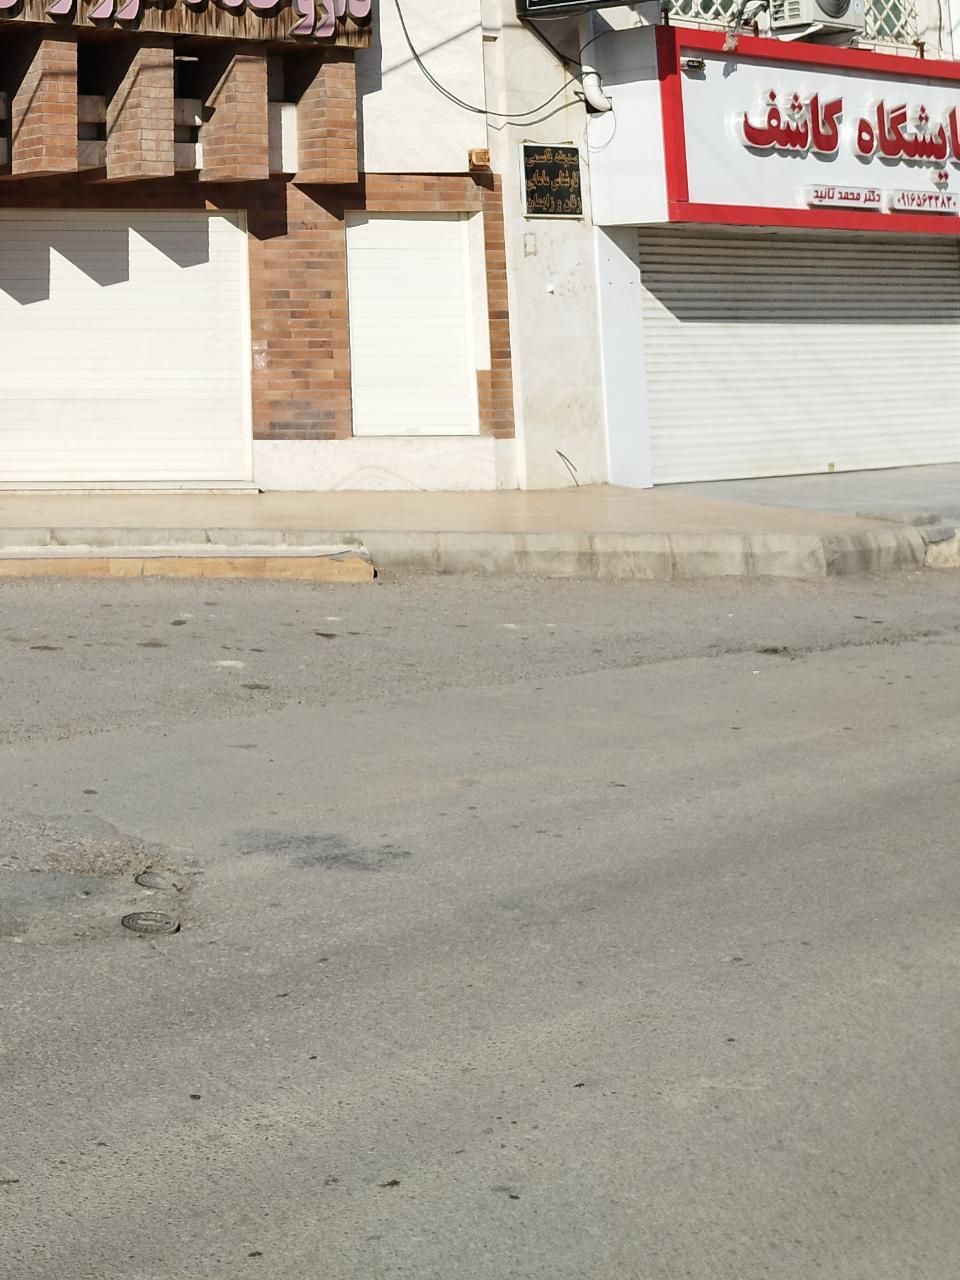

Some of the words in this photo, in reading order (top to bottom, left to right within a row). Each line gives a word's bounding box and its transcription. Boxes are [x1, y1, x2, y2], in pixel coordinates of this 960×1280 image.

[742, 88, 843, 153] کاشف
[856, 99, 960, 183] ایشگاه
[837, 190, 861, 202] محمد
[864, 189, 881, 204] دکتر
